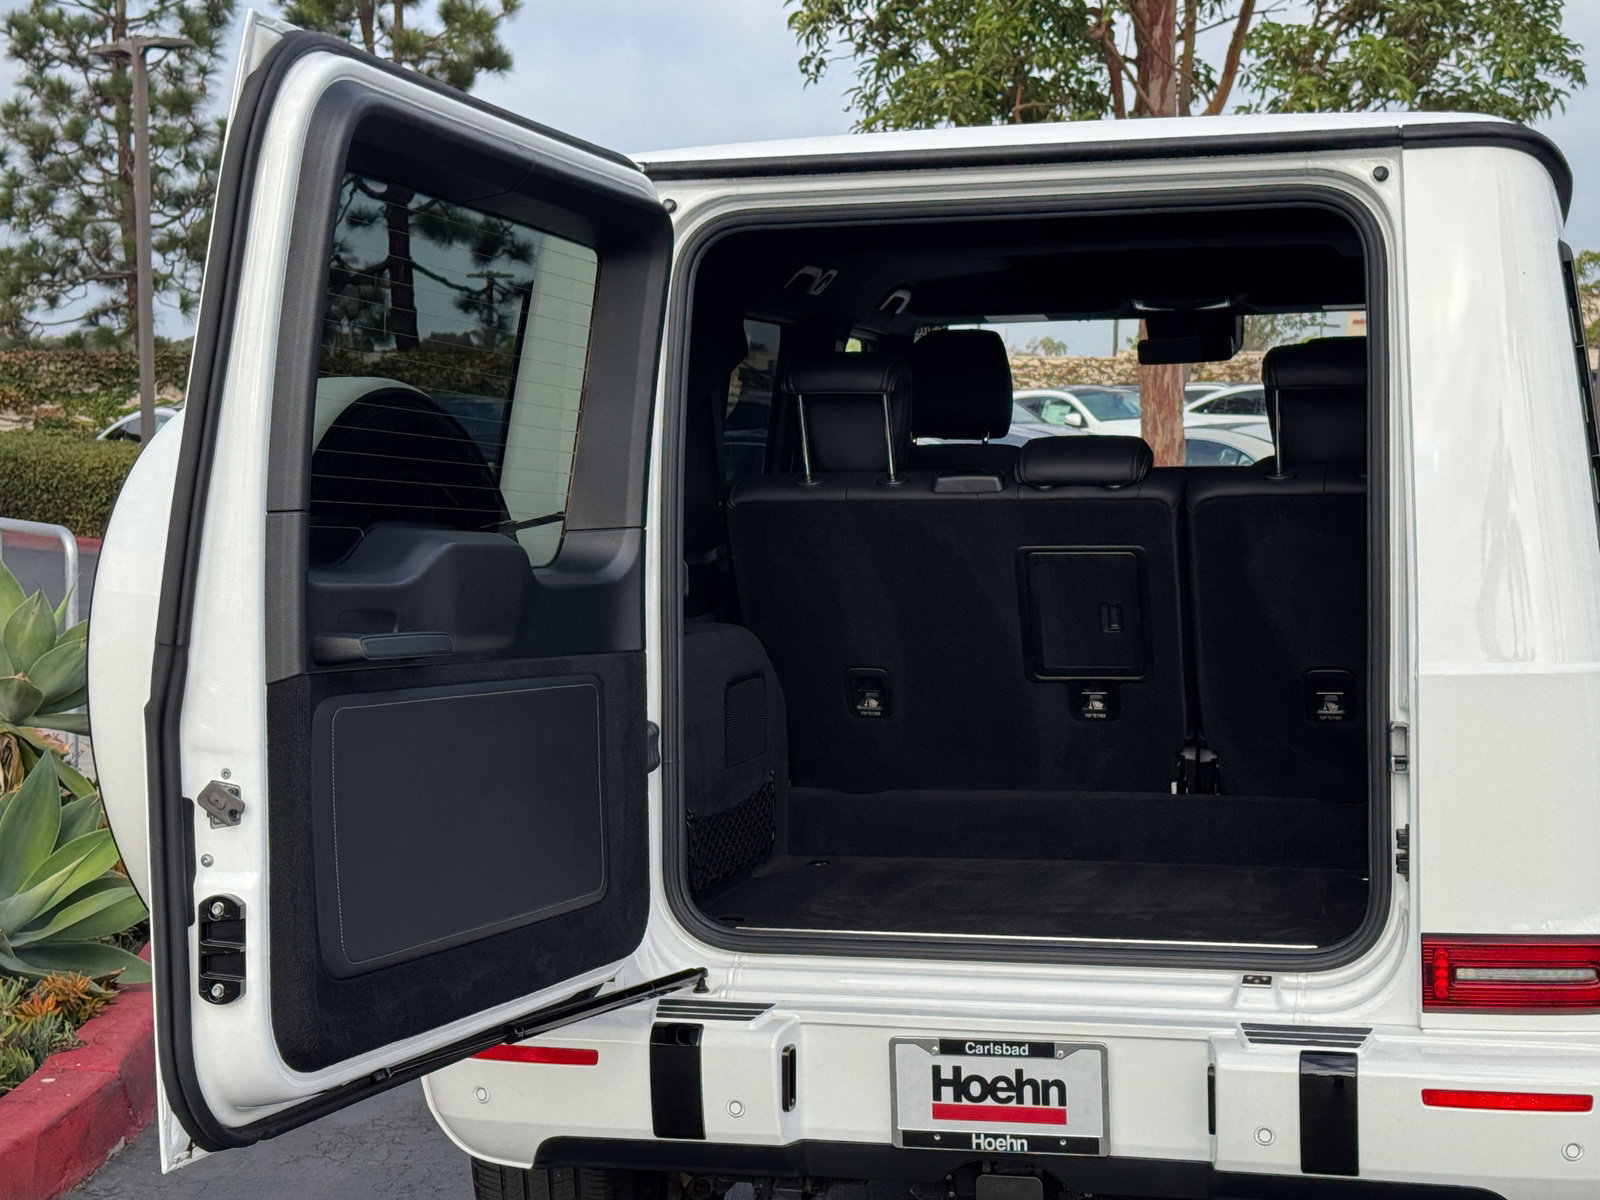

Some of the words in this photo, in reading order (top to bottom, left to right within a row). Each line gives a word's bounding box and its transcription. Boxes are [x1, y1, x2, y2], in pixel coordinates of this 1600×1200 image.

[964, 1041, 1030, 1057] Carlsbad
[931, 1064, 1067, 1107] Hoehn
[971, 1133, 1028, 1152] Hoehn
